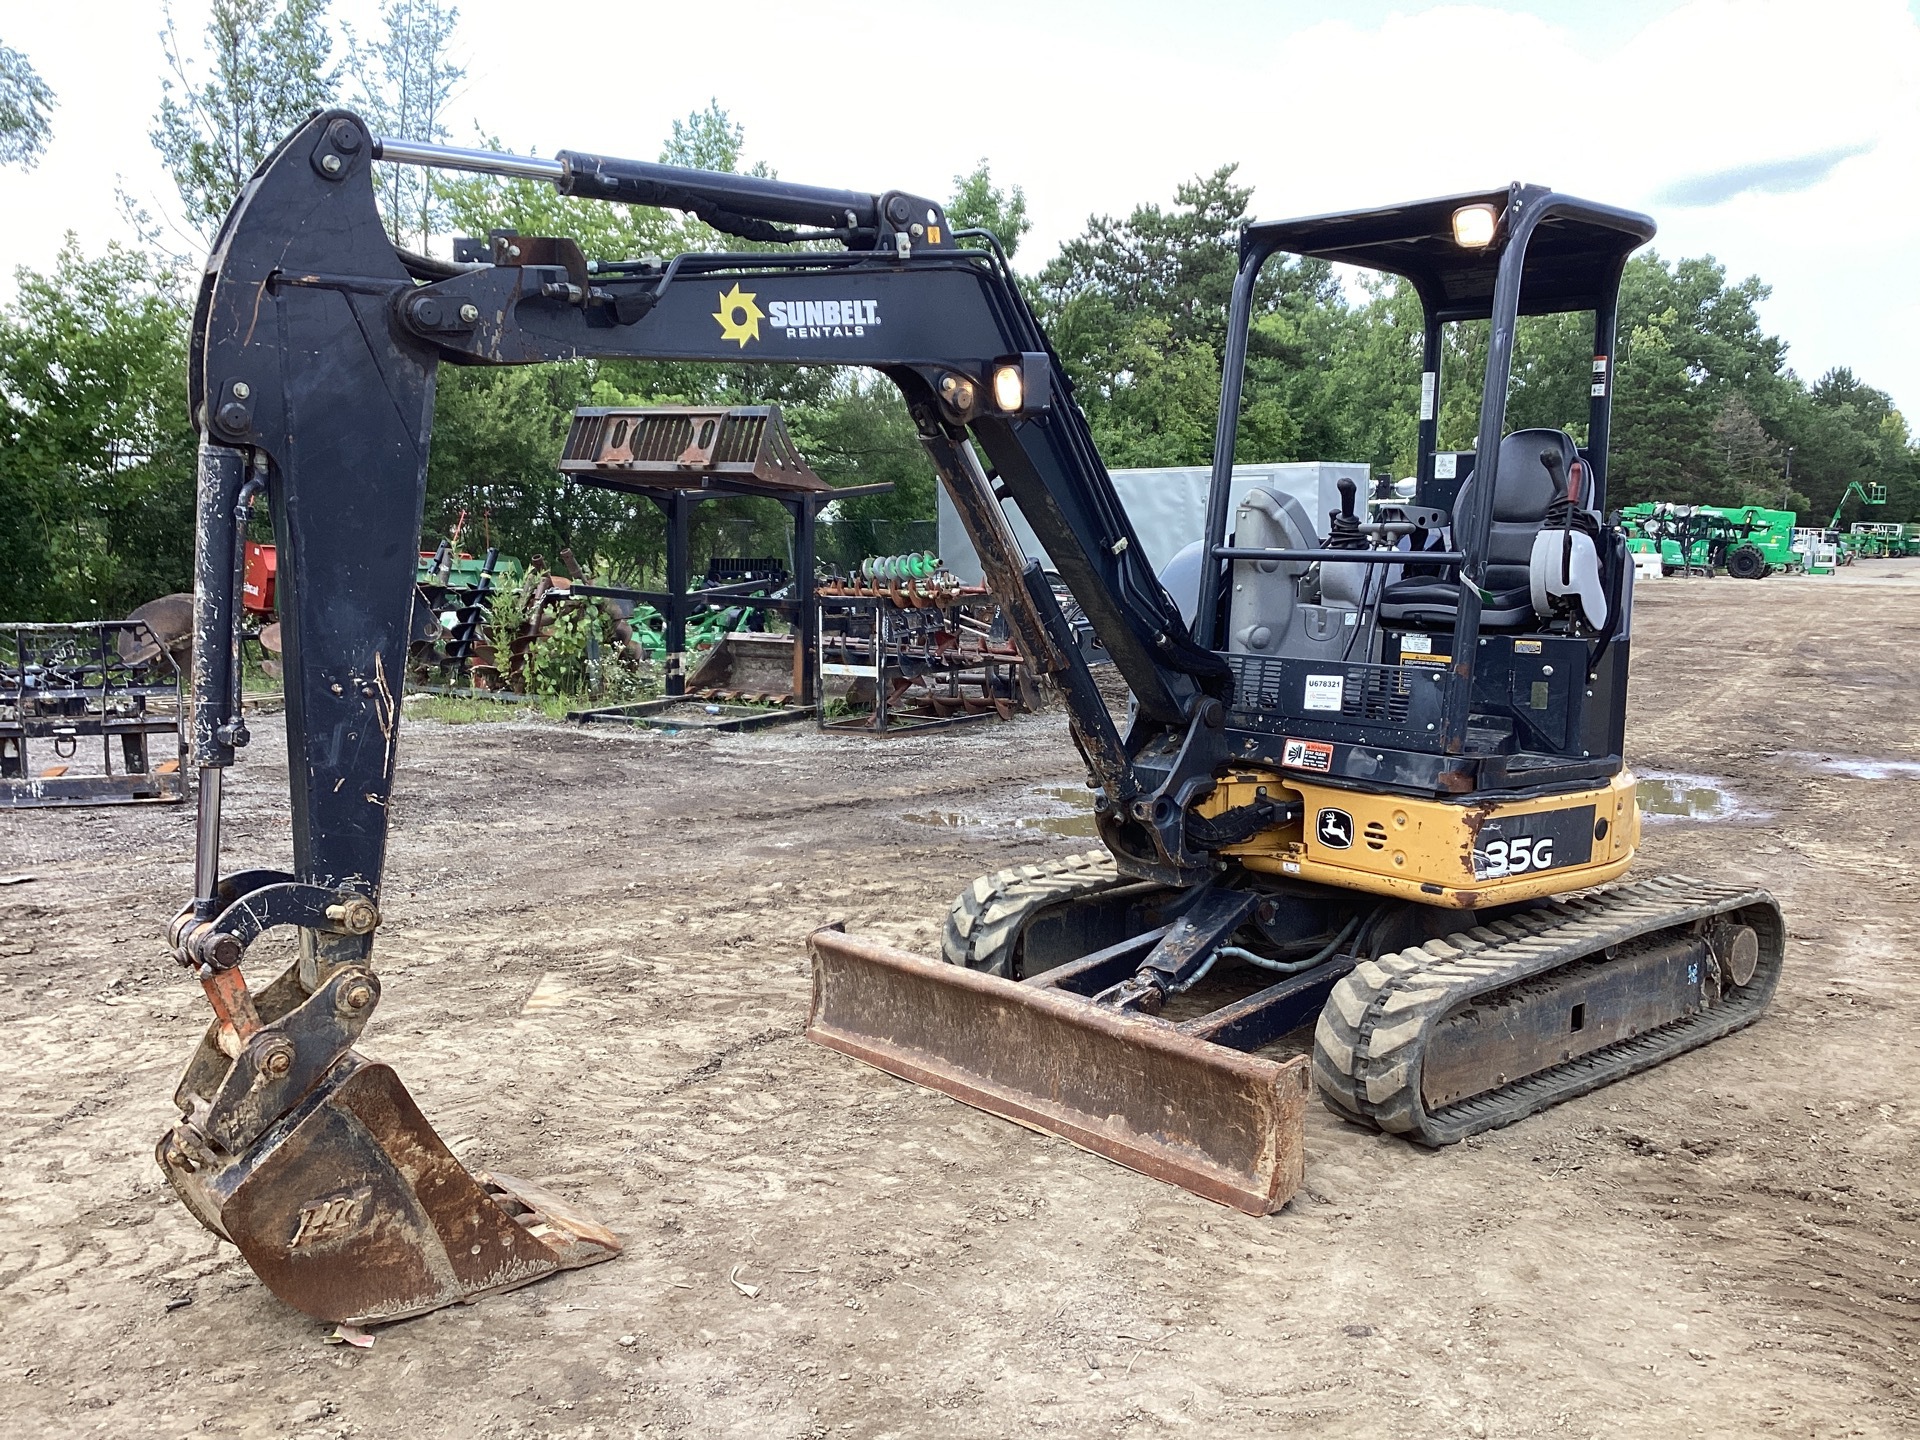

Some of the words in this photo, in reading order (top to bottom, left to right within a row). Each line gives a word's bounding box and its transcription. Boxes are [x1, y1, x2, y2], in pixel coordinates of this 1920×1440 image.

[768, 300, 878, 327] SUNBELT
[786, 326, 865, 338] RENTALS
[1308, 680, 1340, 688] U678321
[1485, 837, 1554, 877] 35G
